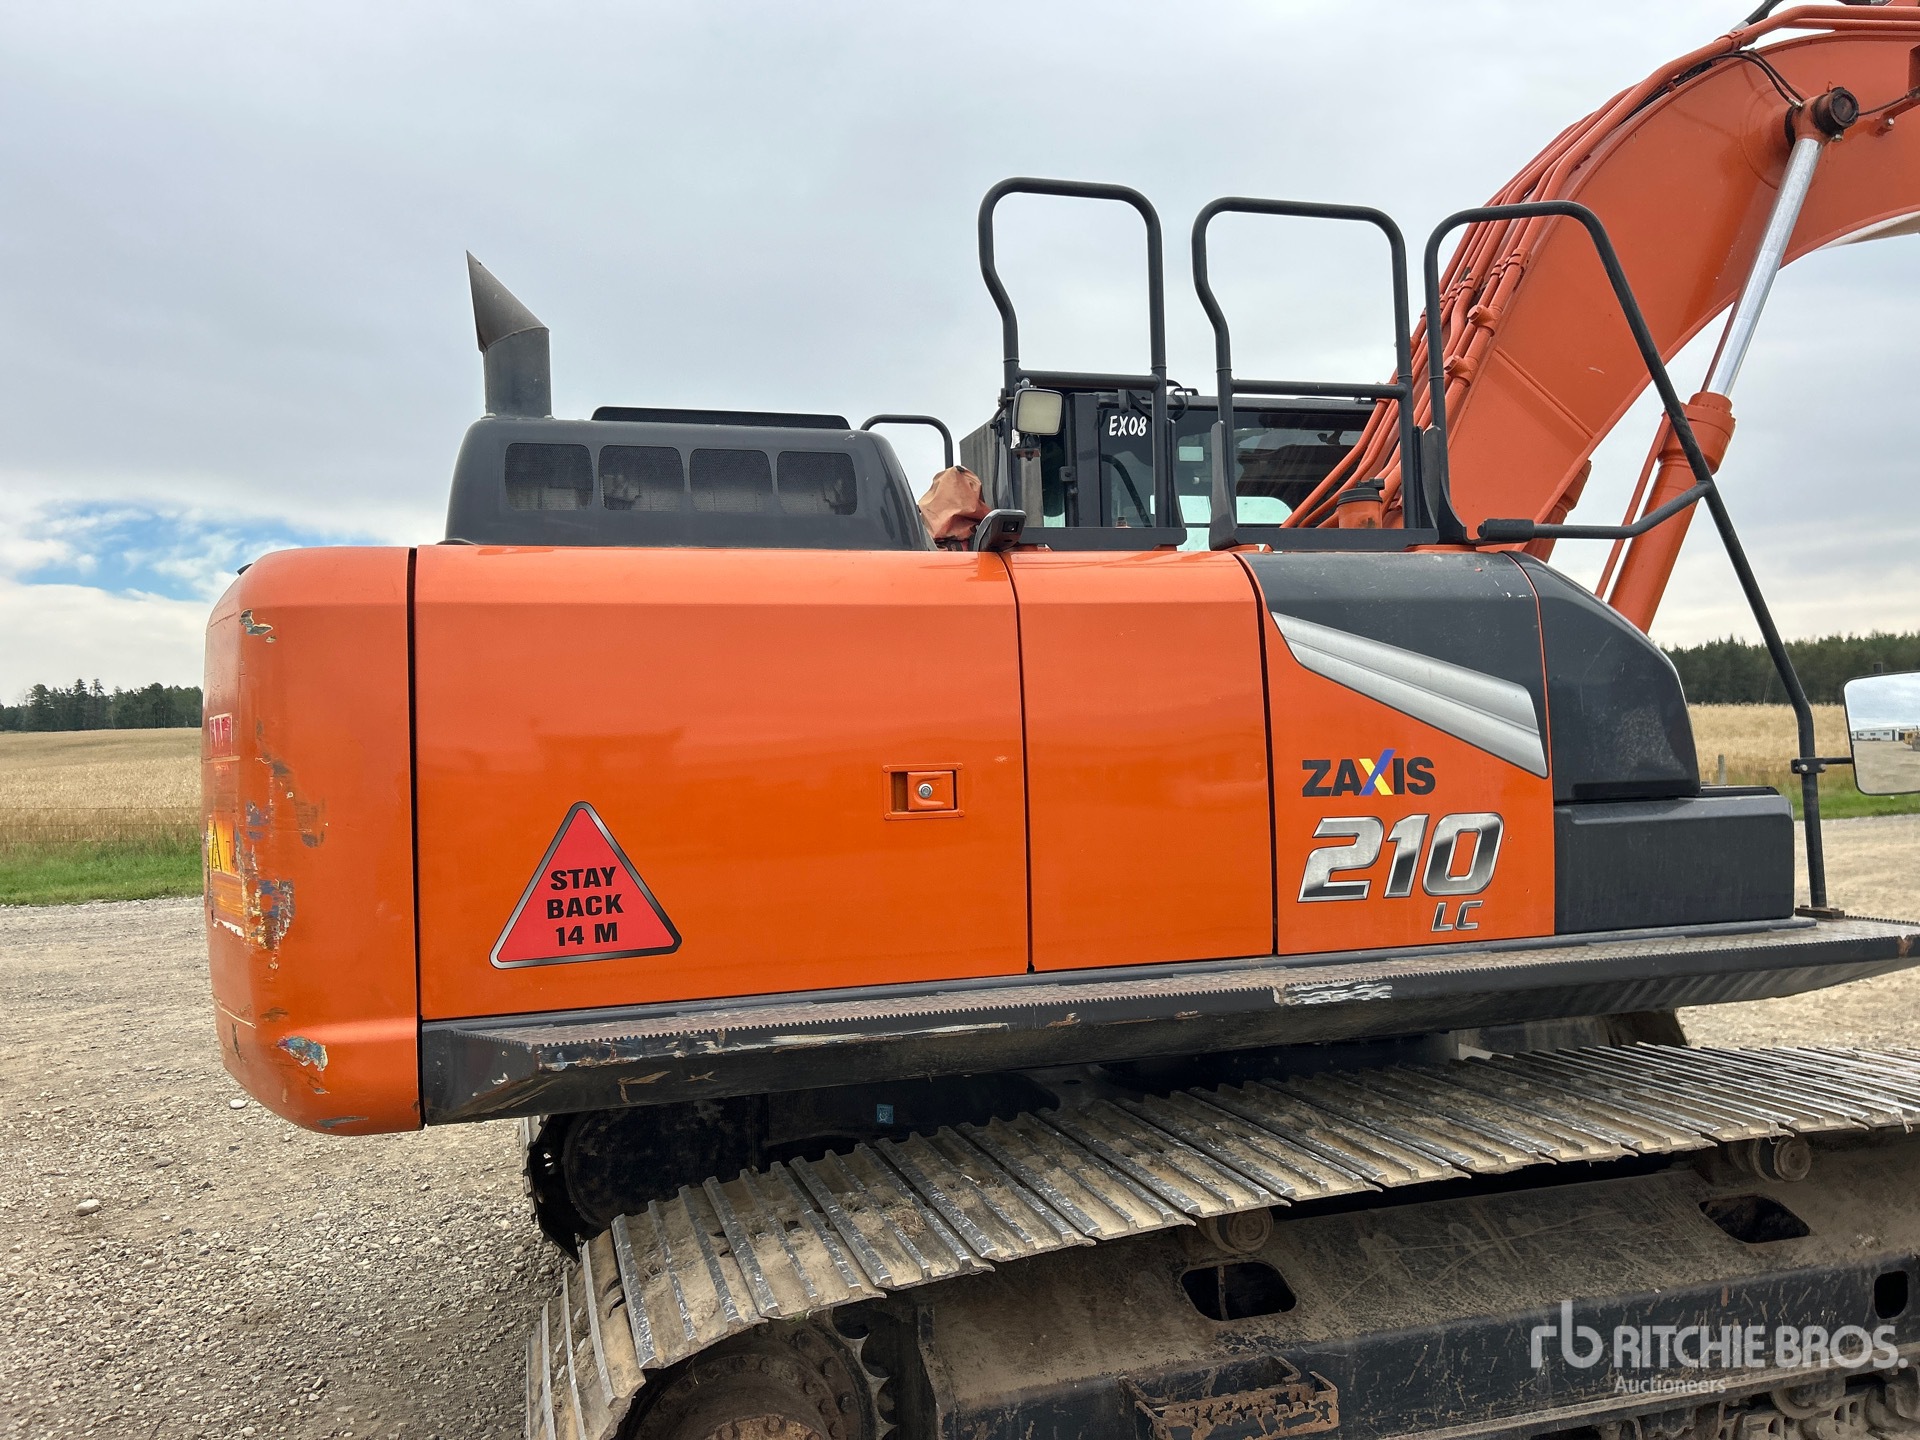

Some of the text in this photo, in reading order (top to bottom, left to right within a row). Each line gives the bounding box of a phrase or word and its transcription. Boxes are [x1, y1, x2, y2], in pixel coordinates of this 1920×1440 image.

[1109, 415, 1147, 437] EX08
[1302, 749, 1436, 797] ZAXIS
[1297, 812, 1504, 903] 210
[551, 867, 617, 891] STAY
[547, 893, 624, 919] BACK
[1431, 900, 1484, 932] LC
[556, 922, 618, 947] 14 M
